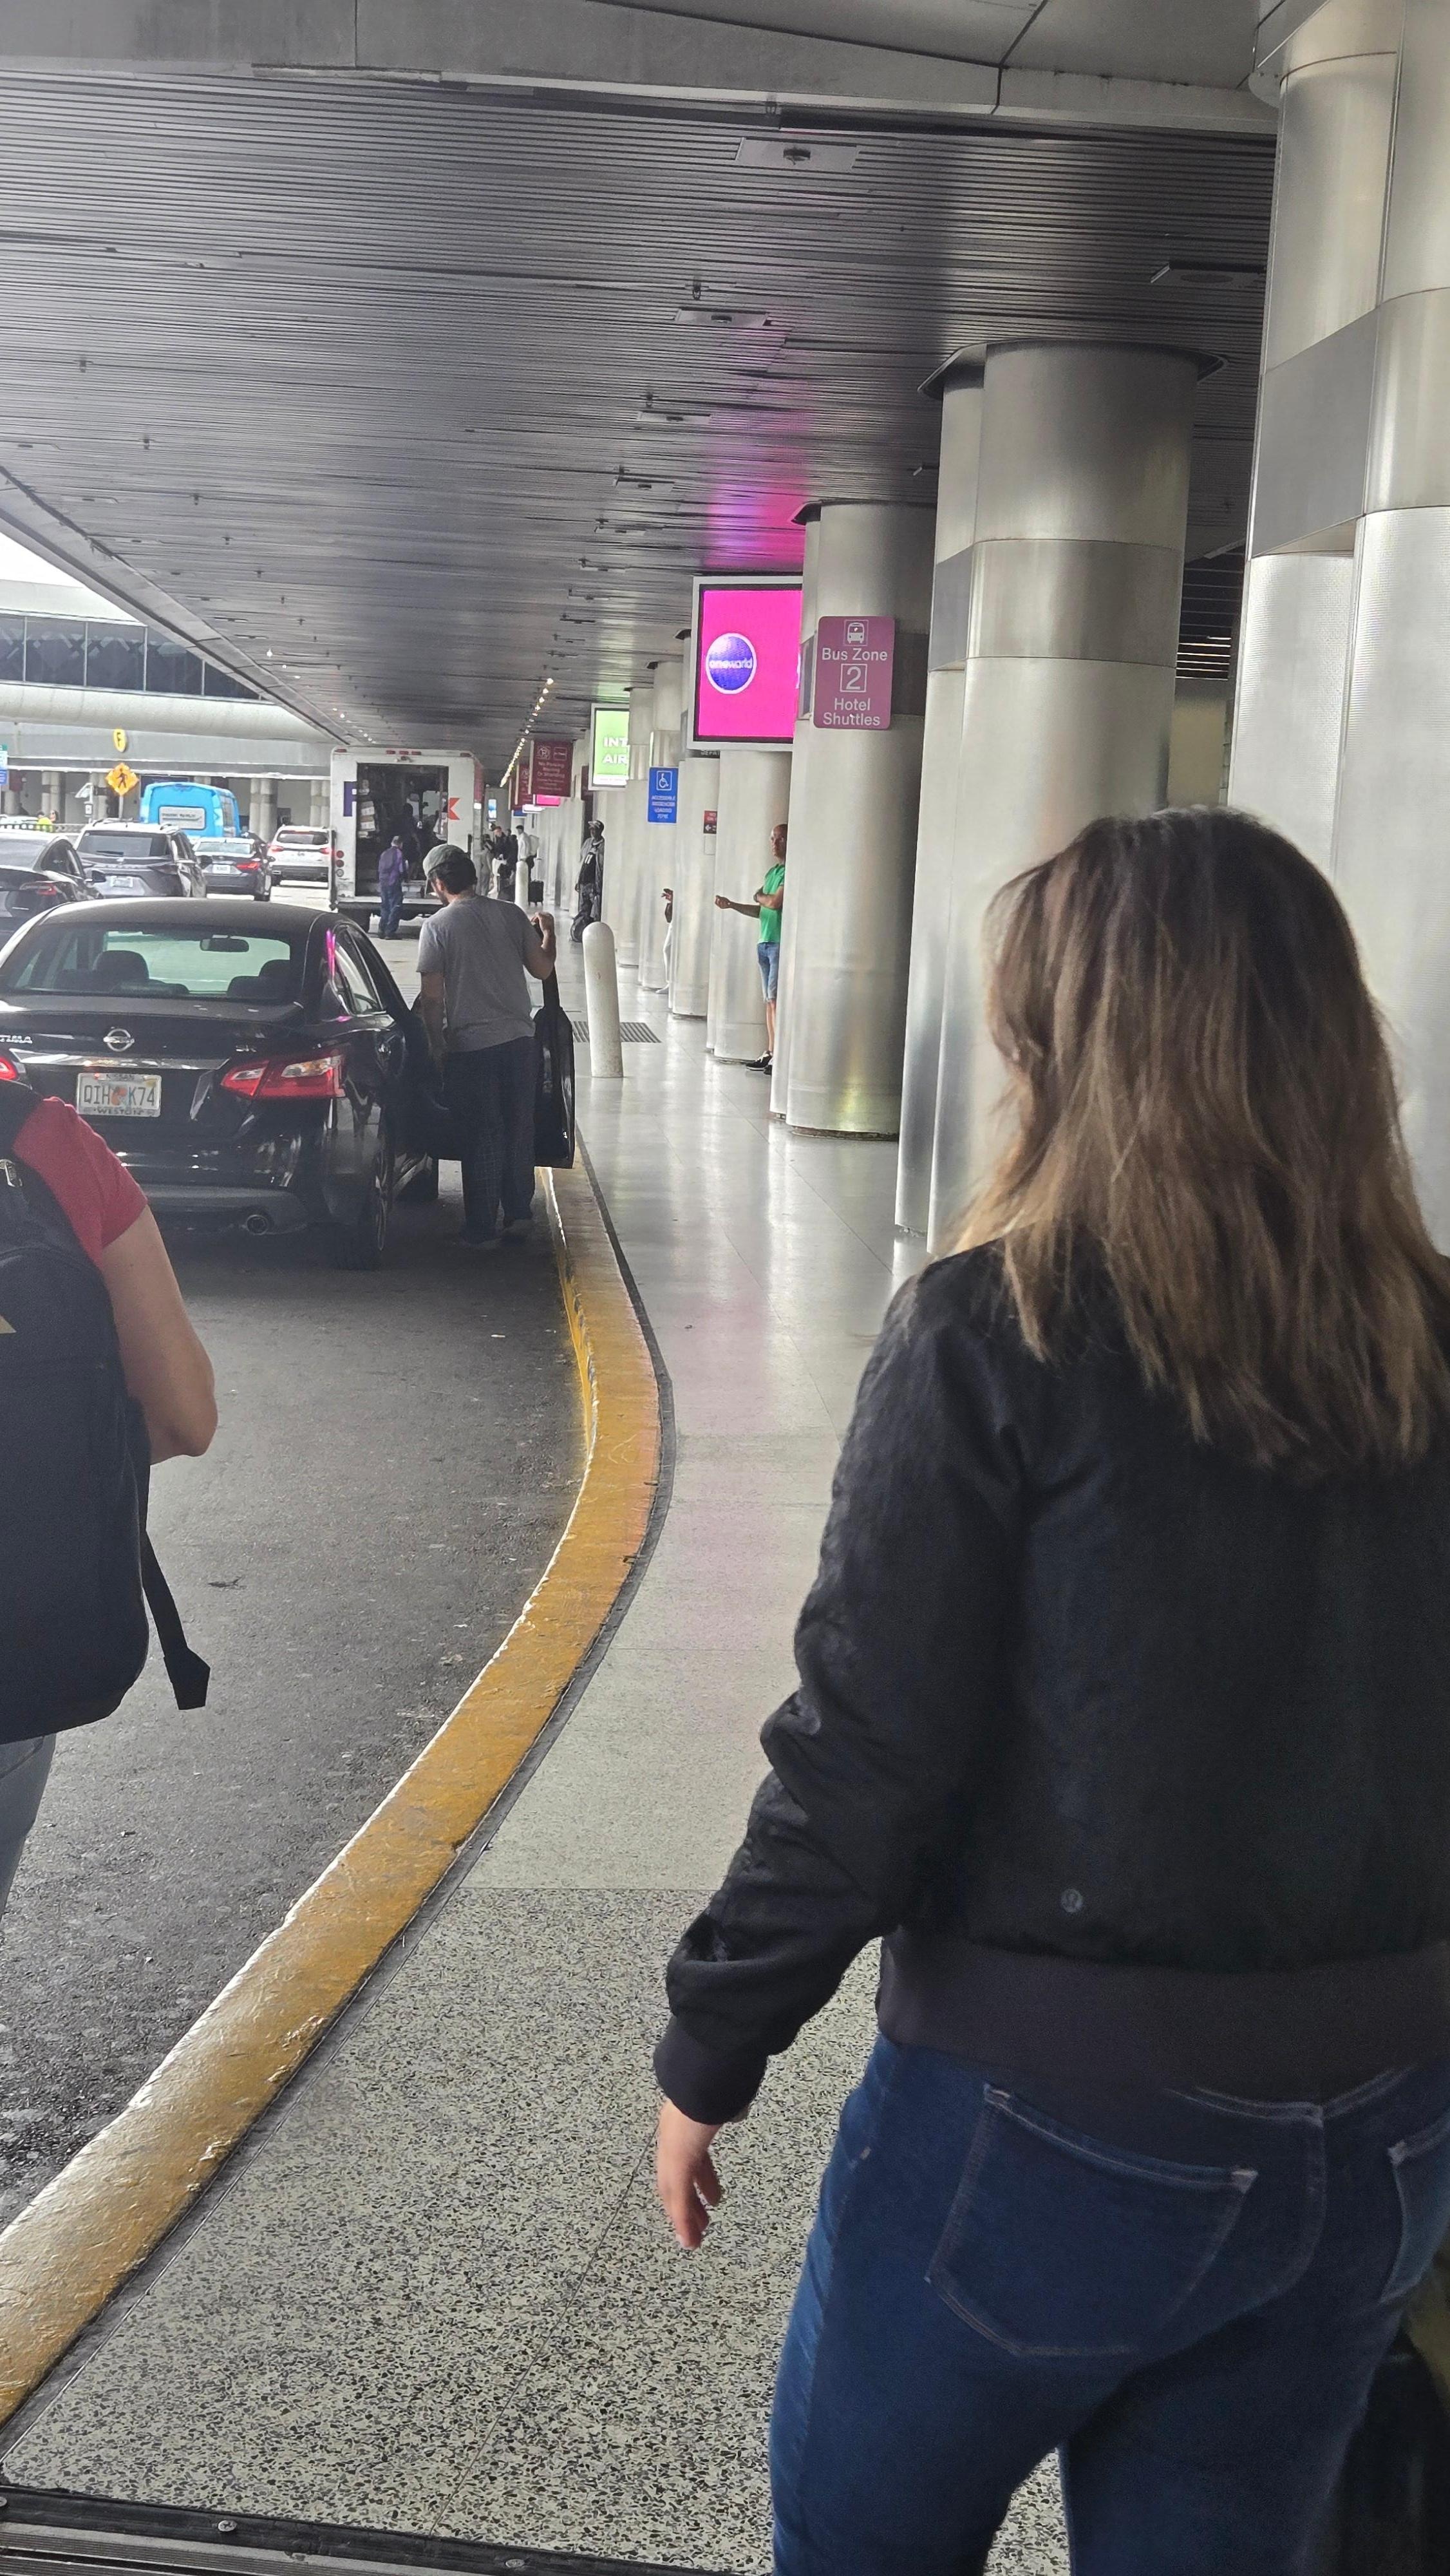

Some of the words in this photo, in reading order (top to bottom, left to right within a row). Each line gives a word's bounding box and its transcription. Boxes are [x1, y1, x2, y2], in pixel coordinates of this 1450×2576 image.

[822, 647, 848, 661] Bus
[852, 648, 888, 661] Zone
[709, 657, 753, 669] oneworld
[845, 666, 862, 690] 2
[834, 697, 871, 711] Hotel
[823, 712, 880, 726] Shuttles
[602, 753, 627, 764] AIR
[84, 1084, 111, 1105] QIH
[129, 1086, 155, 1106] K74
